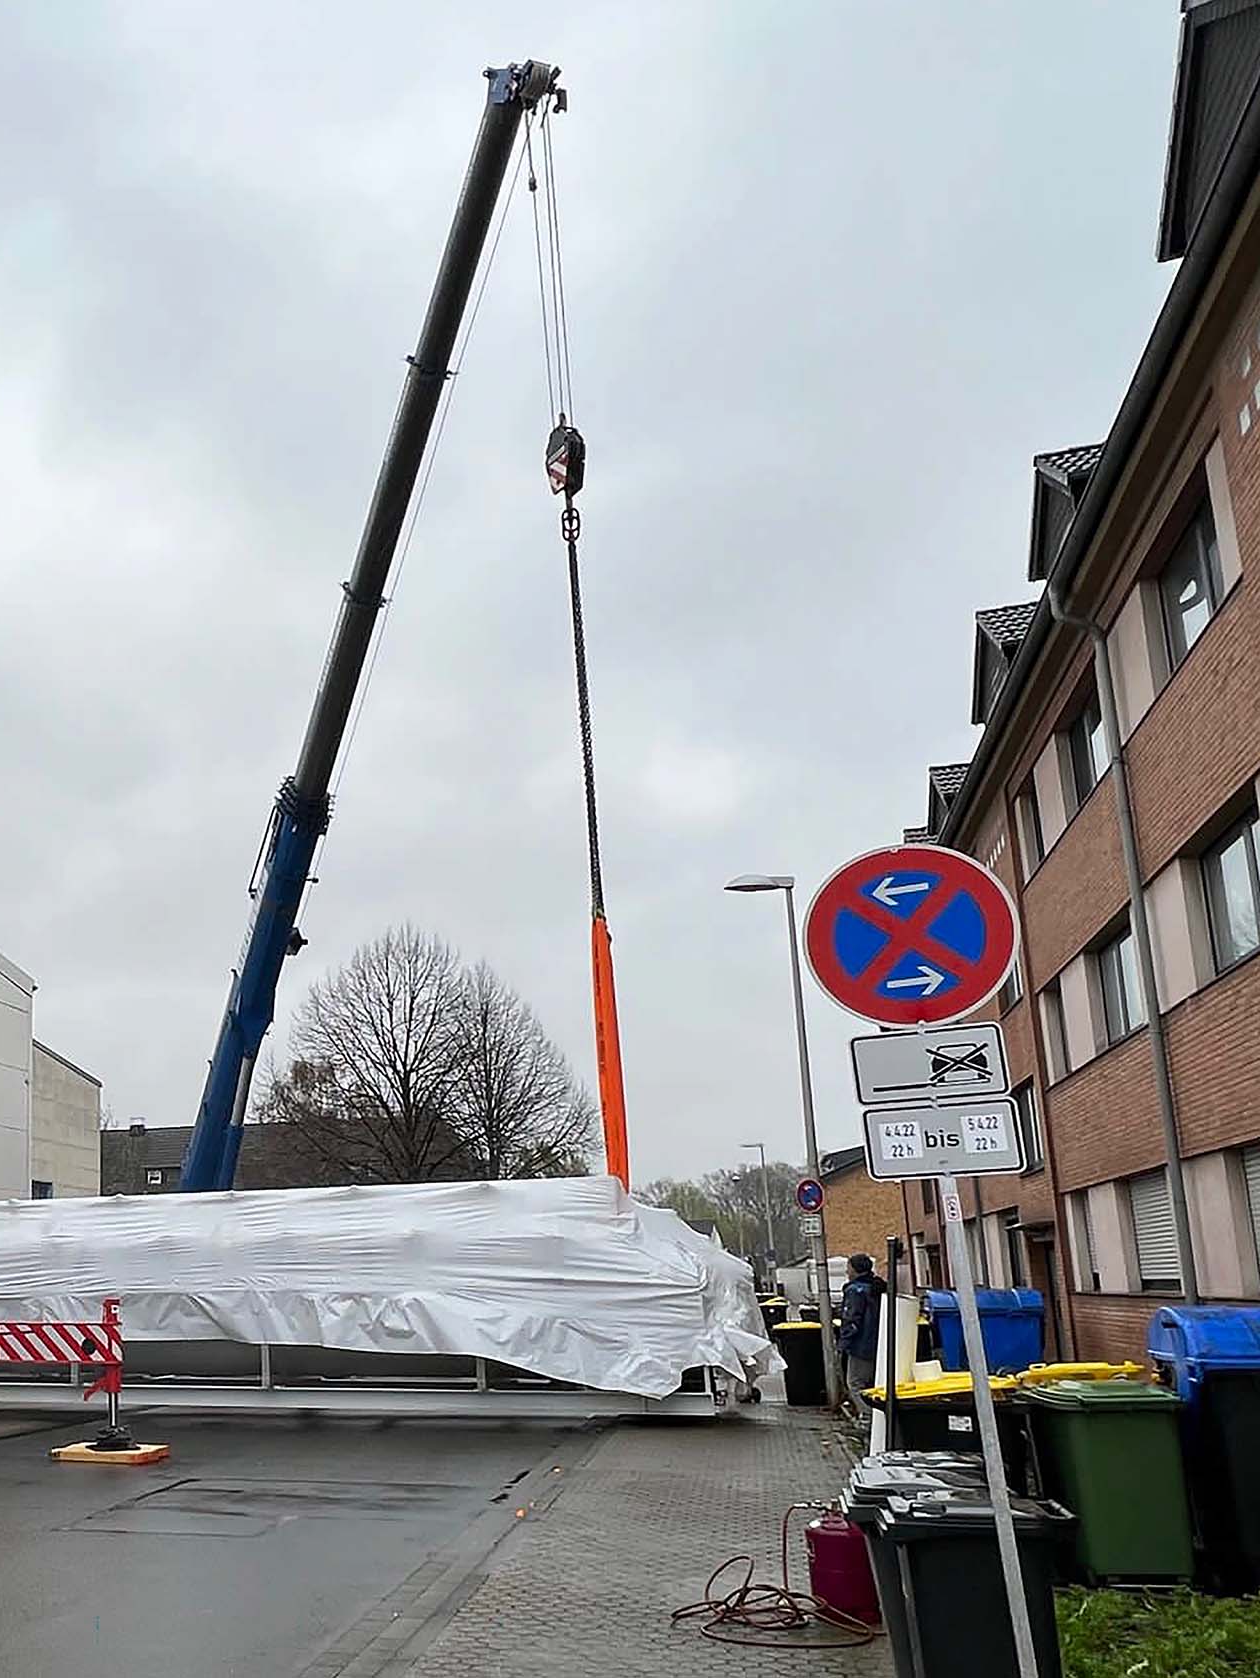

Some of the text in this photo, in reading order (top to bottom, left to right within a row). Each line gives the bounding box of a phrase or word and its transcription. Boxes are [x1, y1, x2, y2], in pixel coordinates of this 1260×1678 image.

[924, 1129, 960, 1148] bis
[975, 1137, 988, 1150] 22
[891, 1144, 904, 1157] 22
